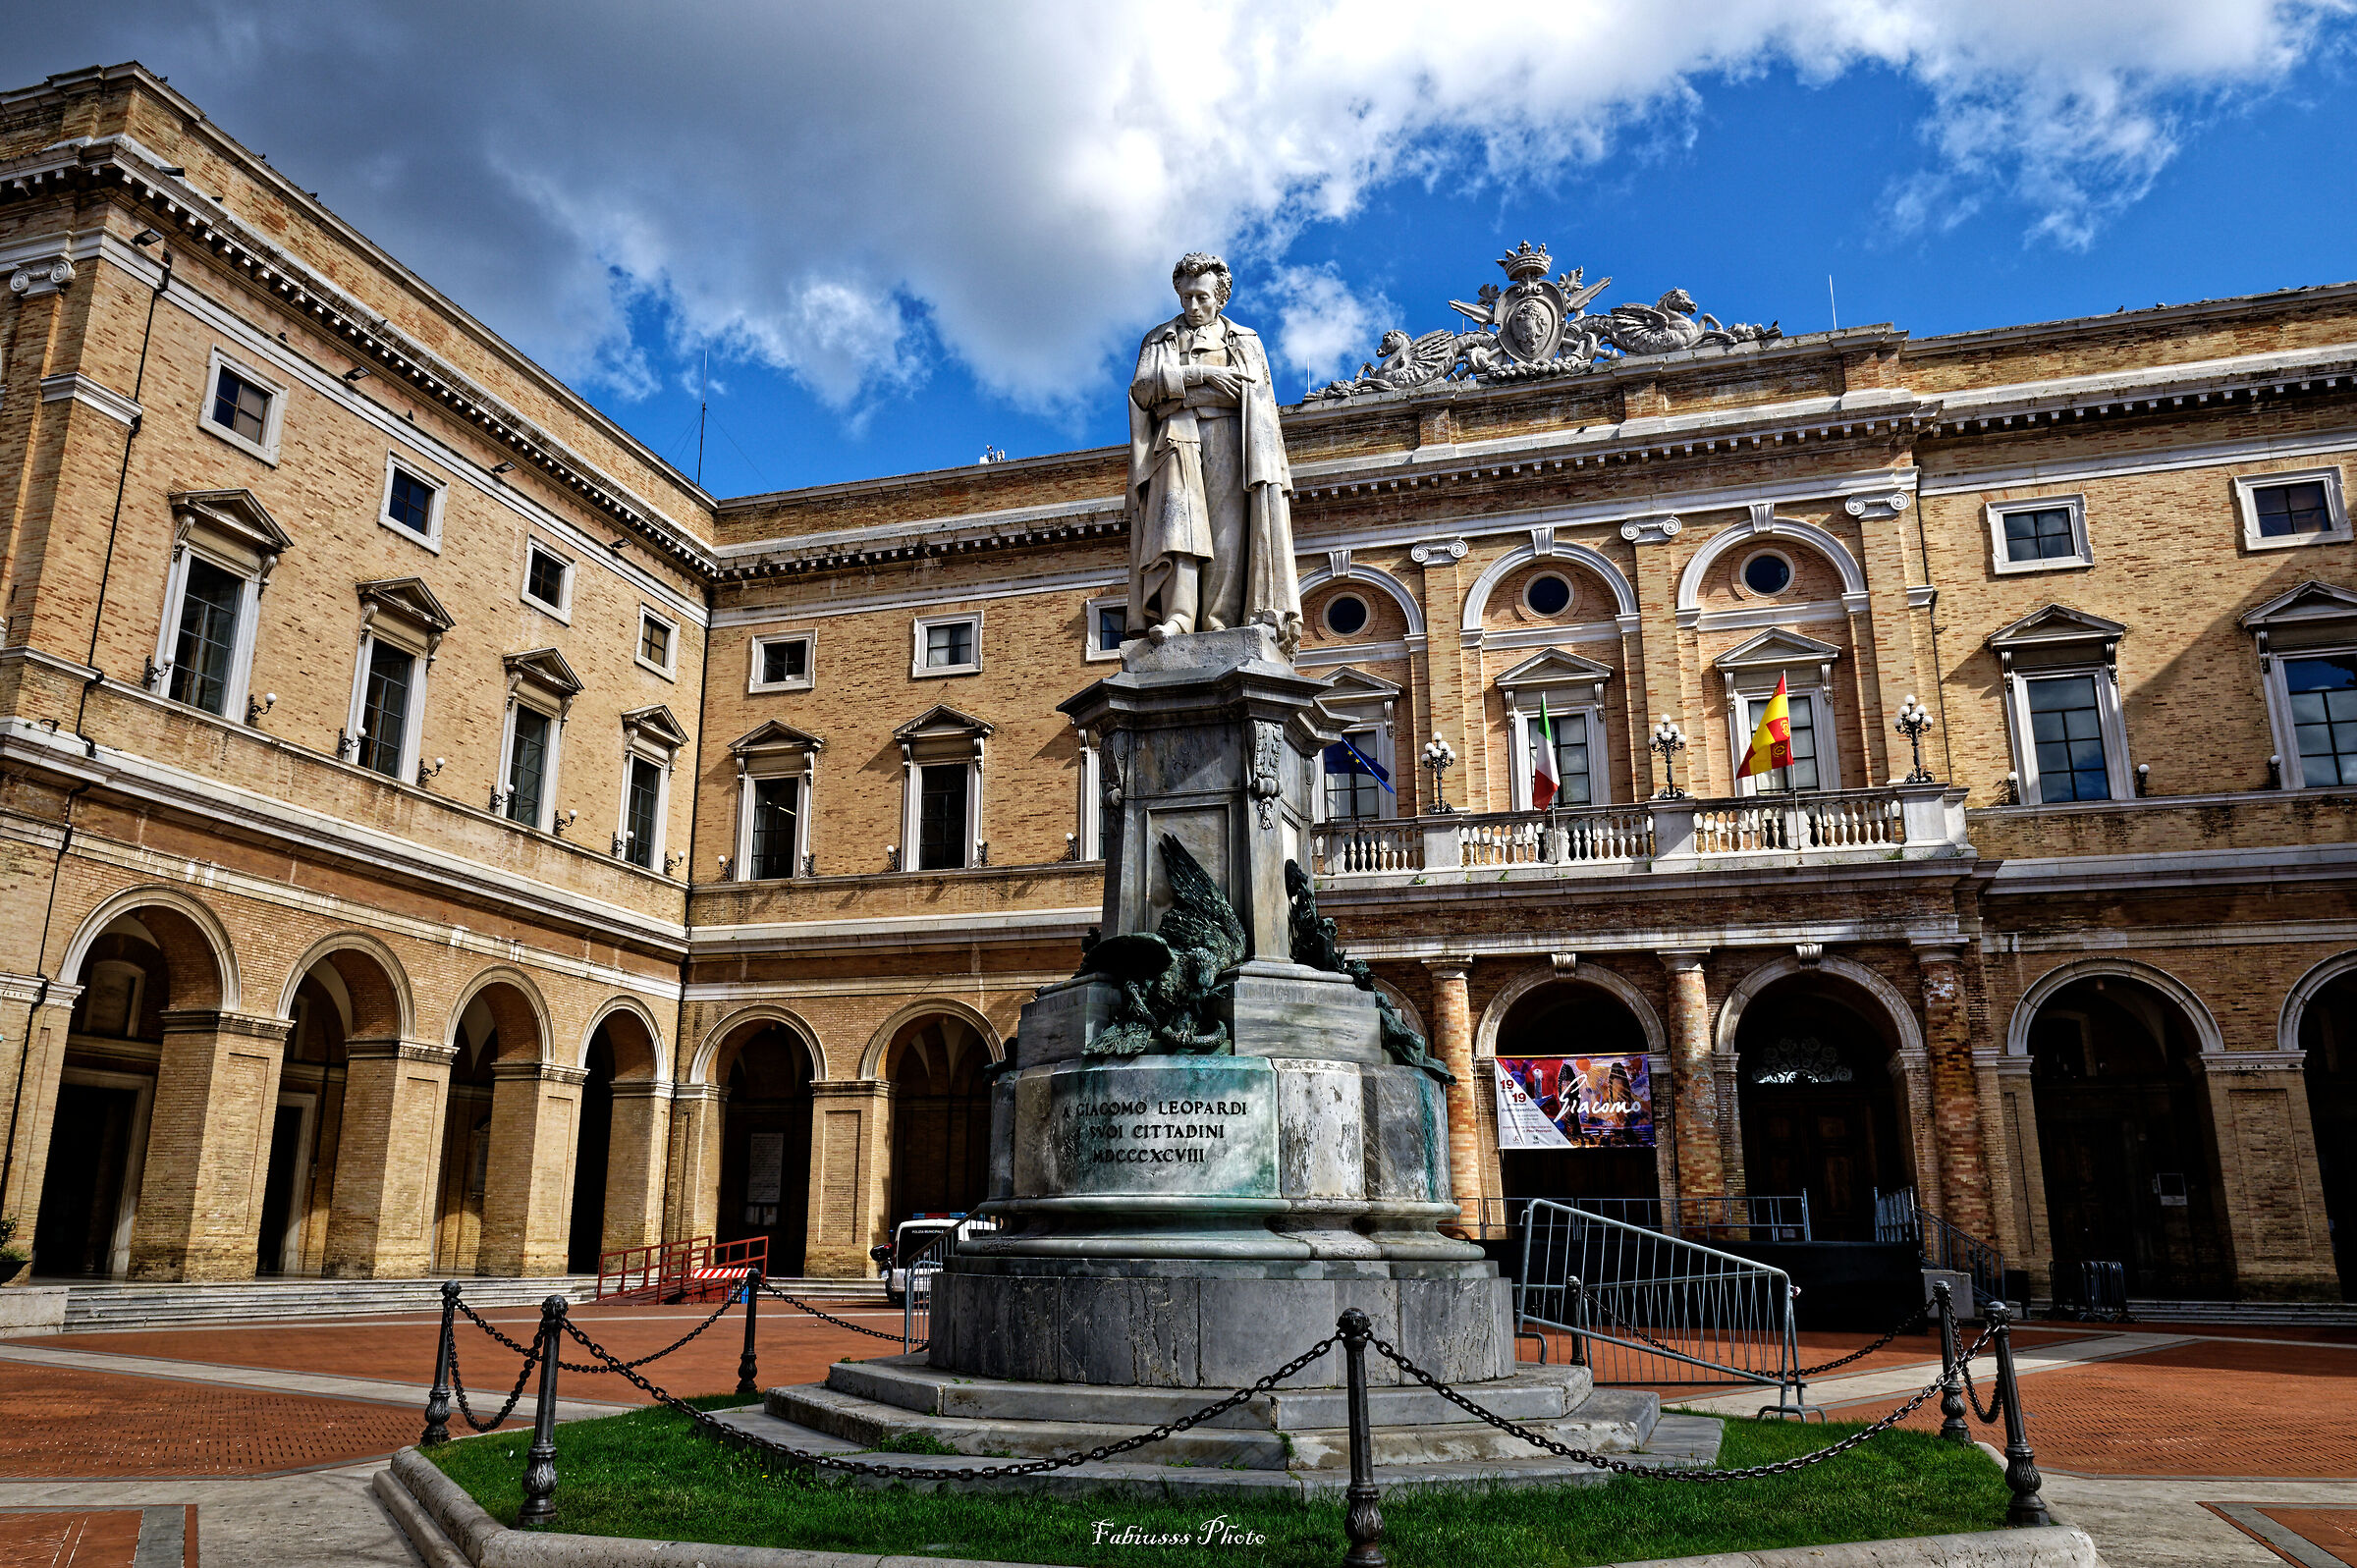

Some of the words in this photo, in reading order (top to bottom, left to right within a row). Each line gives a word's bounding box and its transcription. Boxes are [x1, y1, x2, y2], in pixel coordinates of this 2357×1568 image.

[1501, 1079, 1514, 1090] 19
[1512, 1092, 1527, 1104] 19
[1554, 1074, 1641, 1122] Giacomo
[1063, 1103, 1070, 1117] A
[1076, 1101, 1147, 1116] GIACOMO
[1159, 1101, 1247, 1115] LEOPARDI
[1133, 1124, 1225, 1139] CITTADINI
[1092, 1148, 1205, 1163] MDCCCXCVIII
